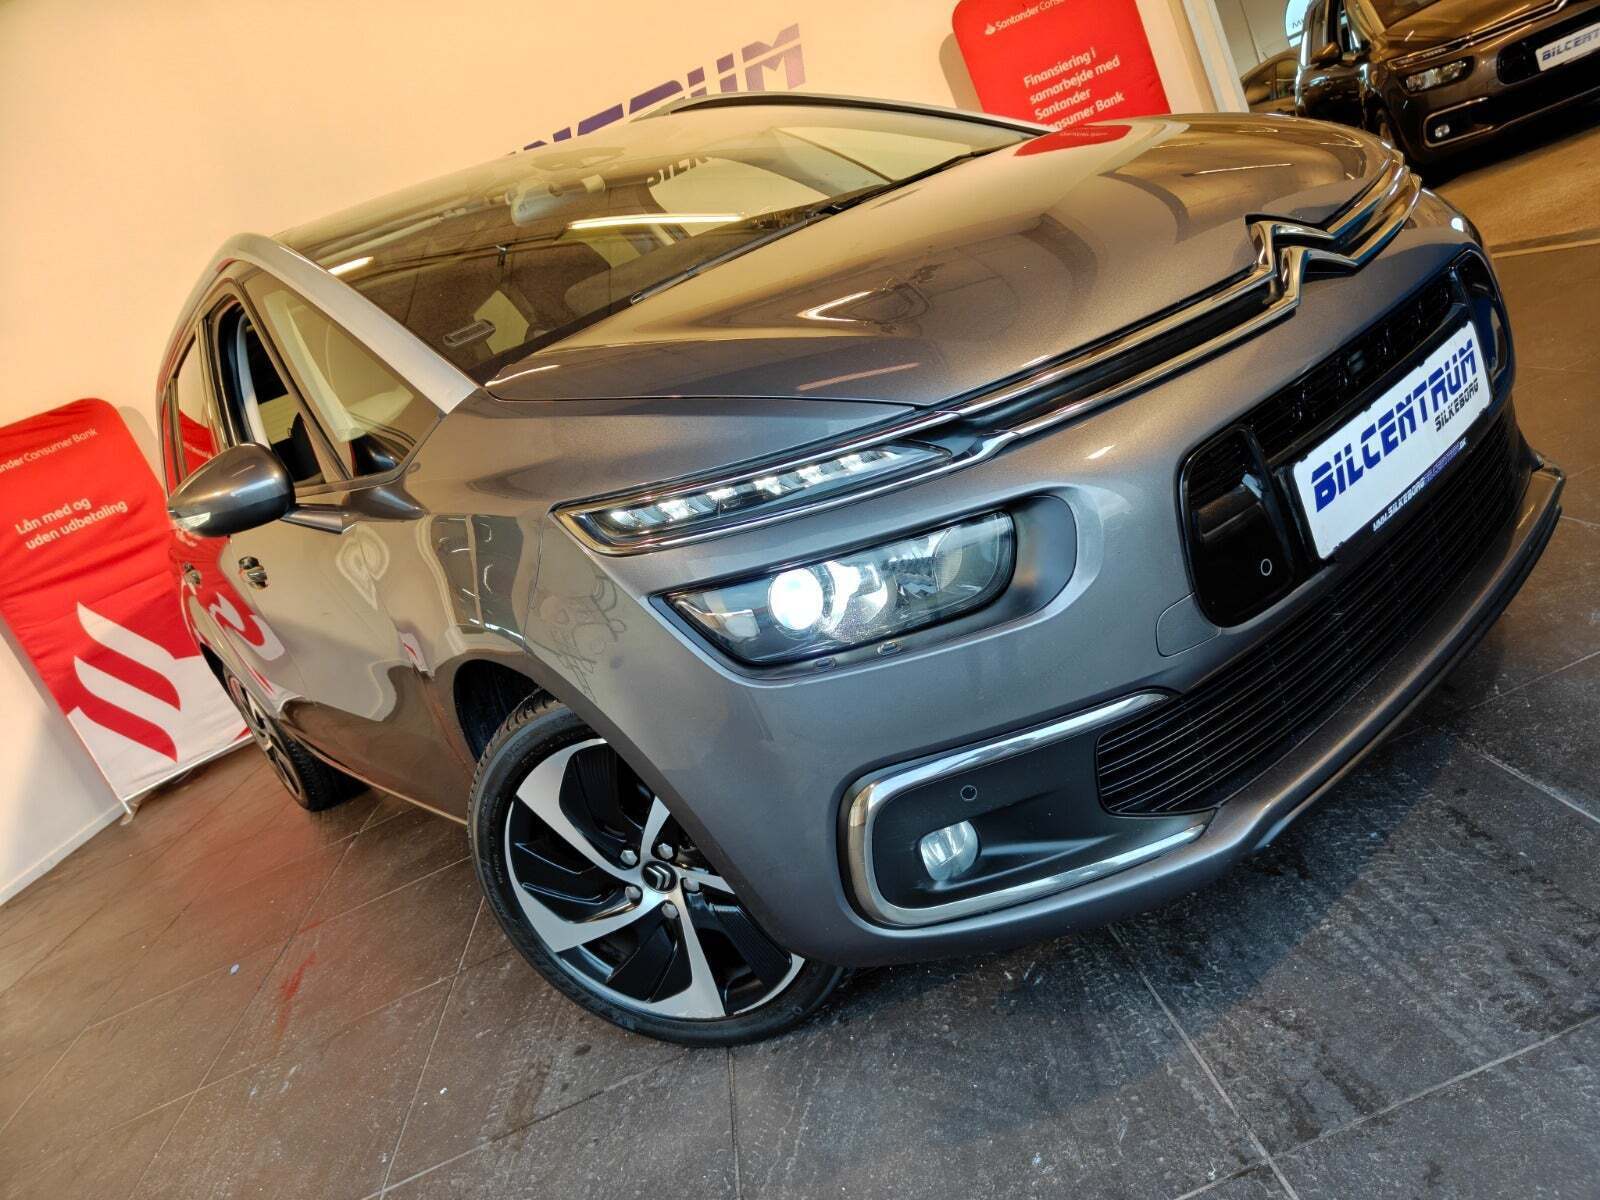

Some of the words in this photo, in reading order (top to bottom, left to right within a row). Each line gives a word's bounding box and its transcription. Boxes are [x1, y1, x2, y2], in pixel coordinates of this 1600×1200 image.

[995, 6, 1039, 31] Santander
[1024, 52, 1091, 88] Finansiering
[1030, 69, 1094, 105] samarbejde
[1095, 54, 1121, 75] med
[1034, 89, 1091, 121] Santander
[1095, 91, 1125, 112] Bank
[1311, 339, 1477, 512] BILCENTRUM
[1434, 378, 1479, 432] SILKEBORG
[0, 457, 24, 473] nder
[24, 438, 72, 462] Consumer
[72, 428, 98, 444] Bank
[15, 518, 42, 535] Lån
[42, 503, 73, 525] med
[73, 498, 92, 511] og
[25, 529, 60, 550] uden
[60, 501, 128, 535] udbetaling
